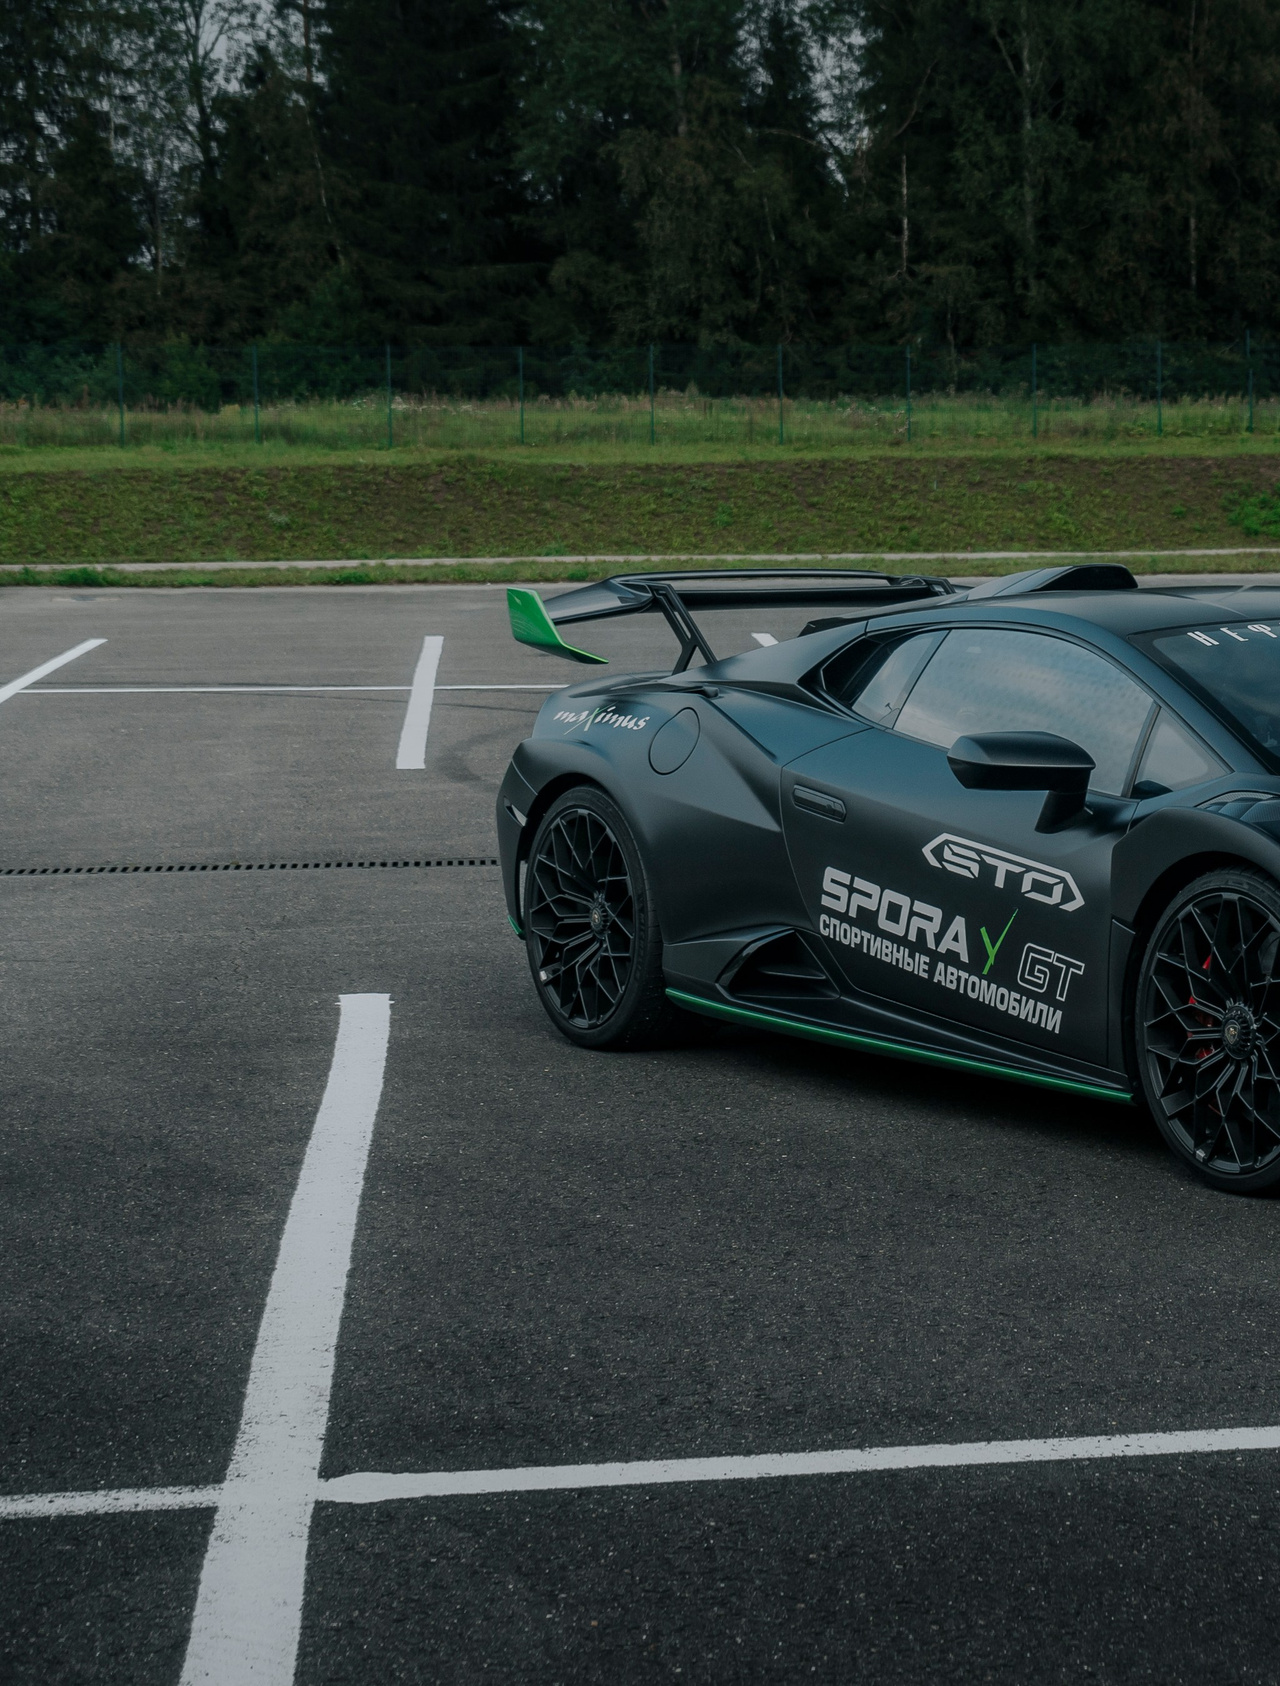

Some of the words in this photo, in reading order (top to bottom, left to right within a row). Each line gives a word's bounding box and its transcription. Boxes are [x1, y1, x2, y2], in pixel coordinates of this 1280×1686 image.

[820, 865, 969, 963] SPORA
[1017, 942, 1085, 1002] GT
[941, 843, 1064, 905] STO
[819, 913, 930, 979] СПОРТИВНЫЕ
[932, 961, 1063, 1034] АВТОМОБИЛИ
